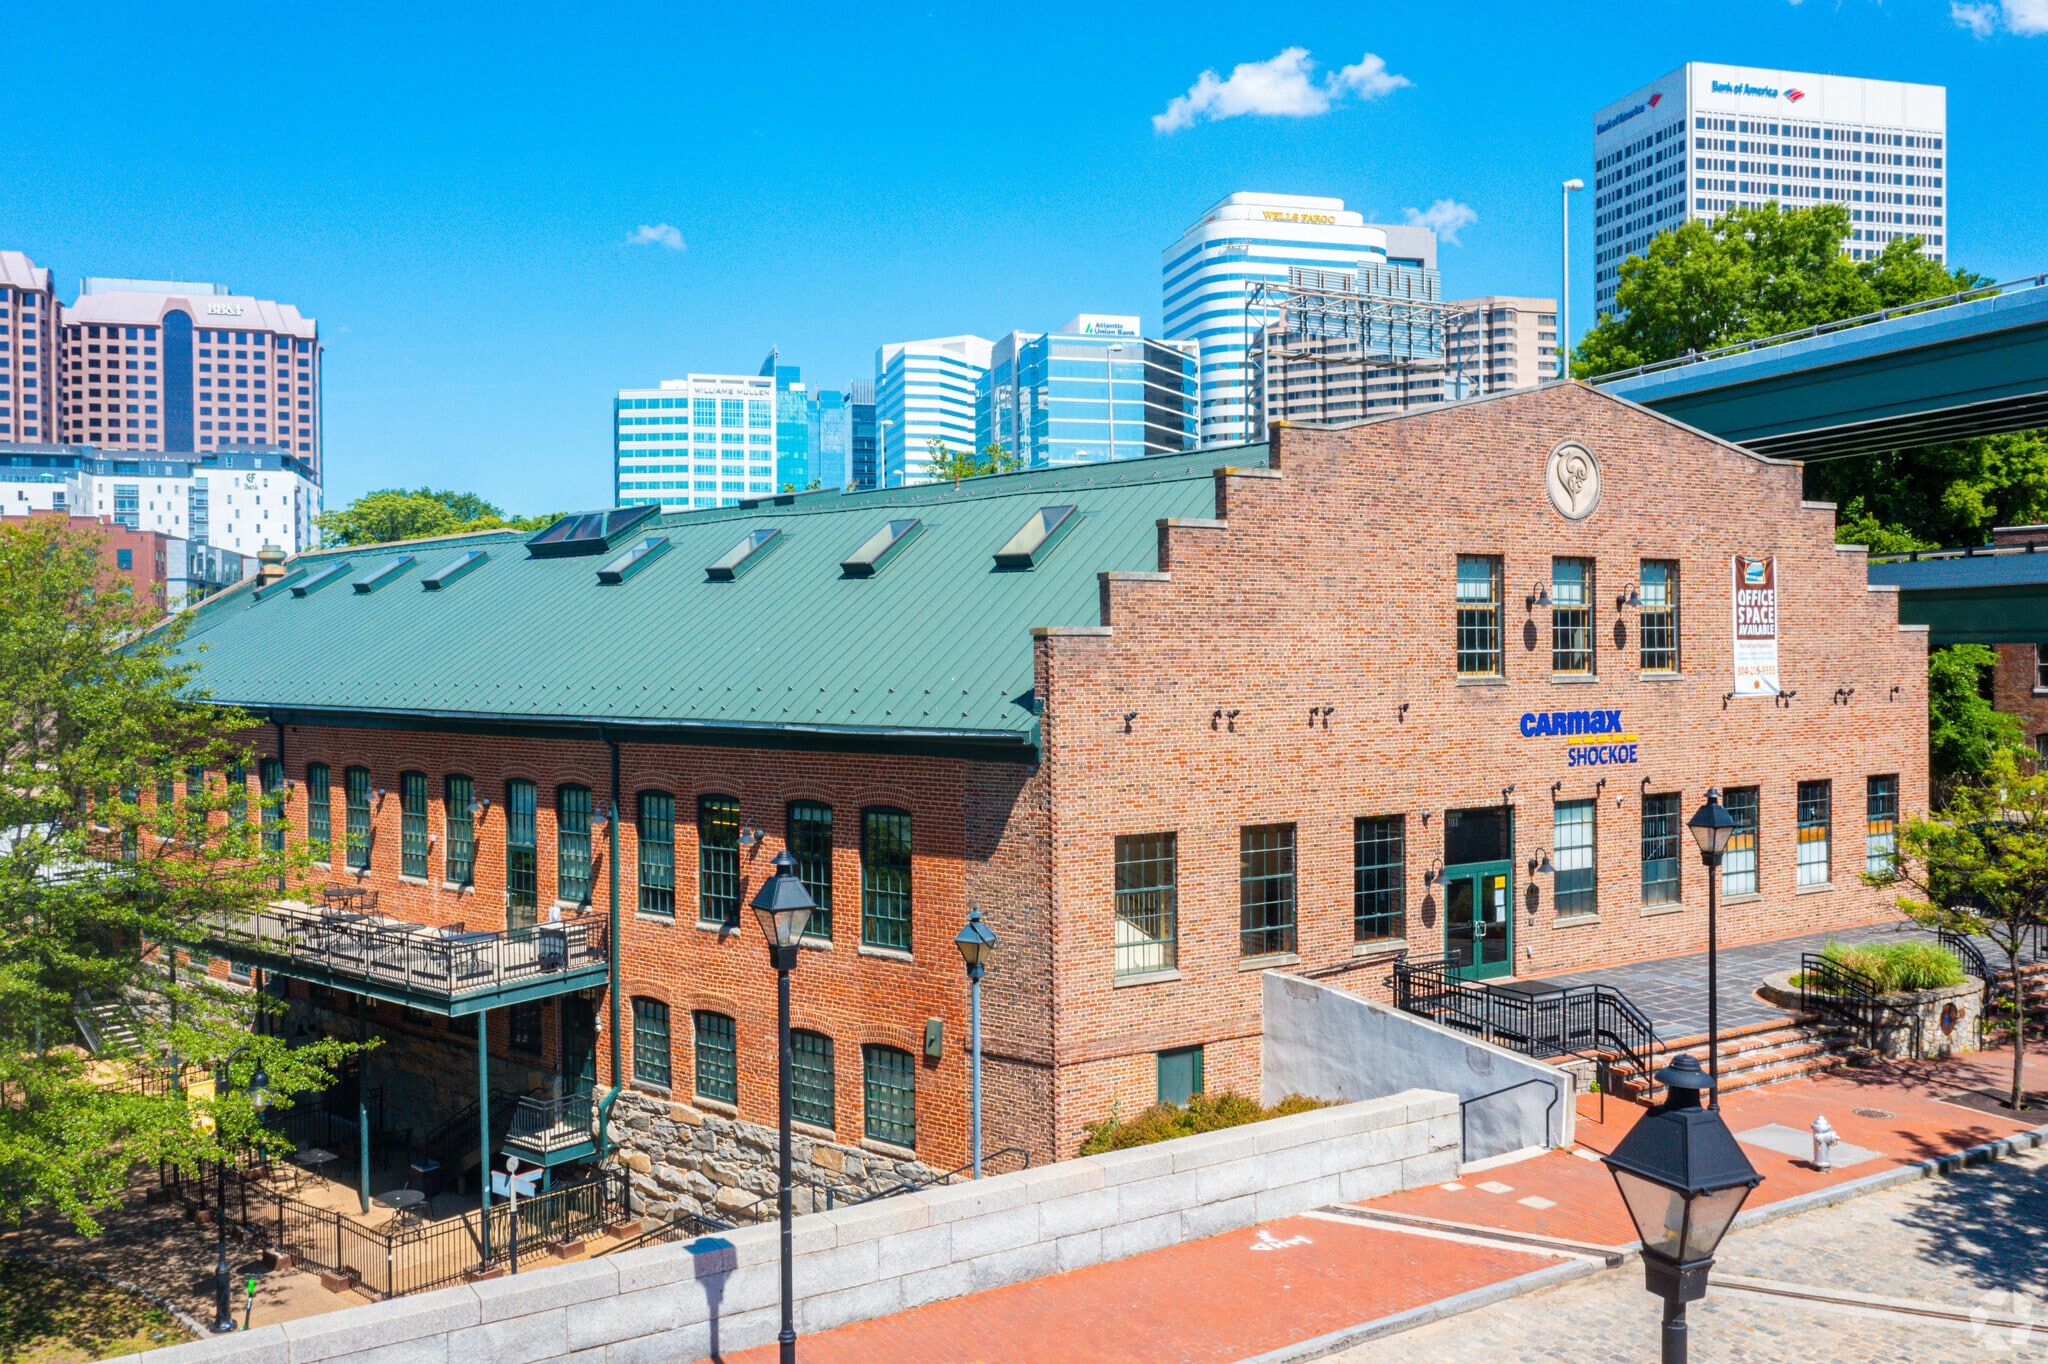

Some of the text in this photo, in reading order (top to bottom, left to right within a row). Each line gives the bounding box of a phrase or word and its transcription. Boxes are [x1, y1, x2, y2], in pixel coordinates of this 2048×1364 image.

[1711, 80, 1778, 97] Bank of America
[1597, 119, 1612, 135] Bank
[1619, 104, 1645, 123] America
[1263, 210, 1336, 224] WELLS FARGO
[207, 303, 242, 316] BB&T
[694, 387, 733, 395] WILLIAMS
[1737, 588, 1774, 607] OFFICE
[1738, 606, 1775, 624] SPACE
[1739, 623, 1775, 636] AVAILABLE
[1568, 744, 1638, 767] SHOCKOE
